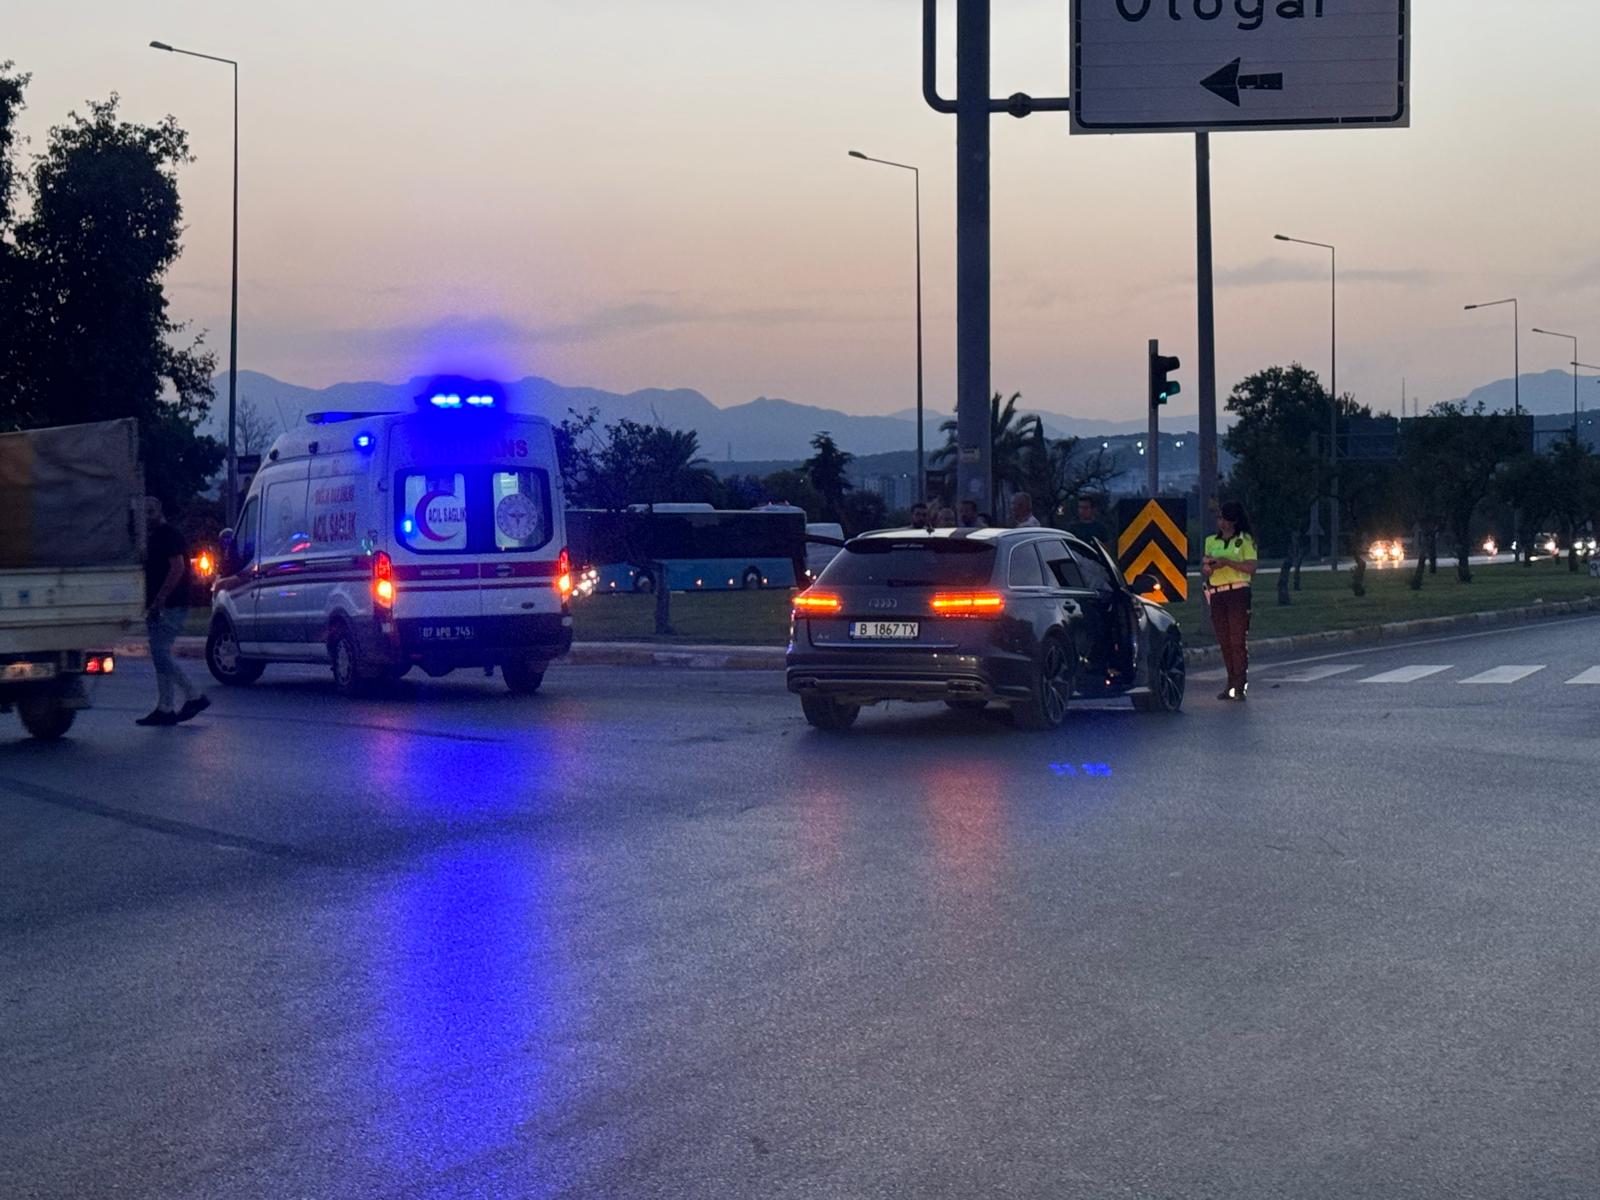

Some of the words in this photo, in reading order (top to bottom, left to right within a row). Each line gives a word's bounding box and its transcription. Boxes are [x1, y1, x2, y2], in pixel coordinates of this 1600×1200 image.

[860, 624, 867, 635] B
[875, 624, 900, 635] 1867
[902, 624, 916, 635] TX
